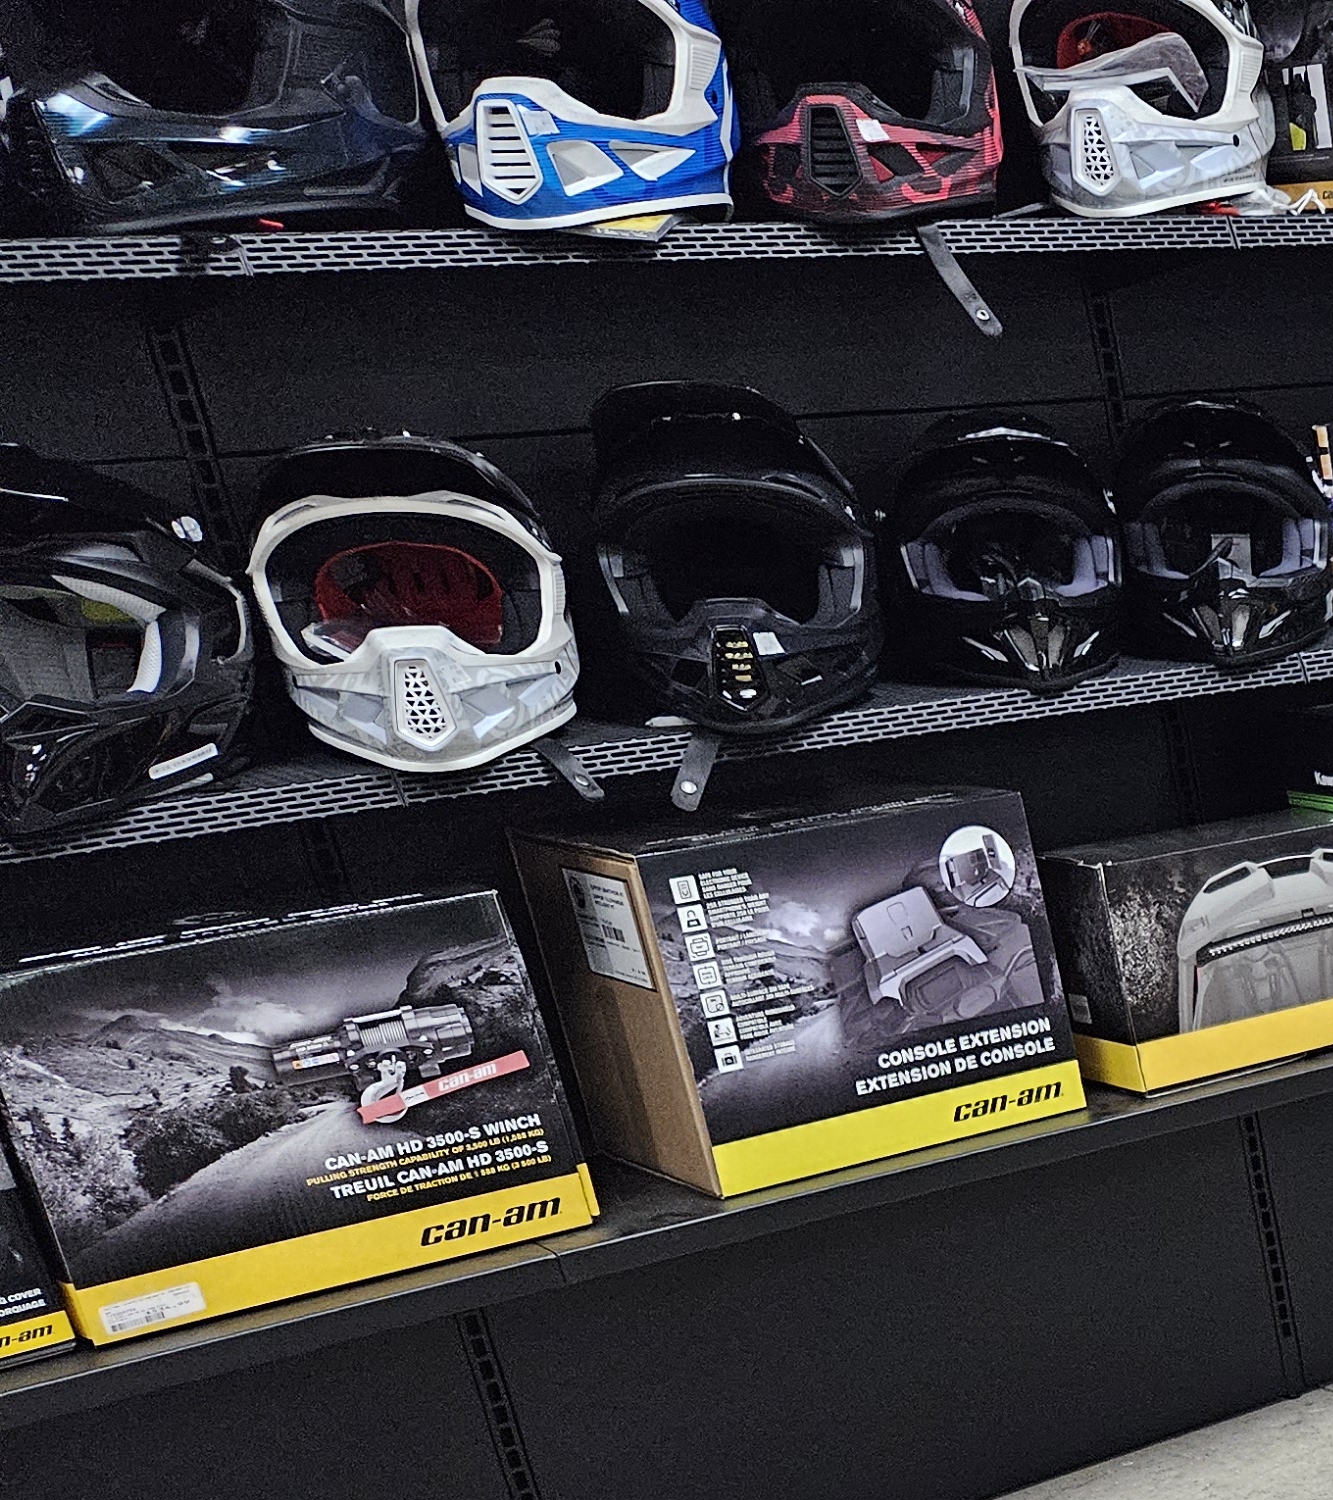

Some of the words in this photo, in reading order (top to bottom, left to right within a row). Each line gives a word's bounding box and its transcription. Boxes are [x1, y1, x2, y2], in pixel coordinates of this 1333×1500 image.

[855, 1060, 952, 1096] EXTENSION
[954, 1054, 979, 1073] DE
[980, 1036, 1056, 1067] CONSOLE
[877, 1038, 958, 1069] CONSOLE
[958, 1016, 1052, 1051] EXTENSION
[438, 1063, 498, 1092] can-am
[953, 1081, 1062, 1122] can-am
[306, 1171, 348, 1187] PULLING
[348, 1160, 398, 1177] STRENGTH
[399, 1148, 450, 1167] CAPABILITY
[451, 1145, 465, 1154] OF
[489, 1137, 501, 1147] LB
[324, 1143, 395, 1171] CAN-AM
[397, 1139, 424, 1156] HD
[425, 1126, 482, 1150] 3500-S
[482, 1113, 542, 1137] WINCH
[329, 1172, 395, 1199] TREUIL
[397, 1161, 464, 1184] CAN-AM
[467, 1155, 492, 1170] HD
[495, 1140, 549, 1163] 3500-S
[367, 1188, 400, 1202] FORCE
[400, 1185, 414, 1195] DE
[415, 1175, 459, 1192] TRACTION
[459, 1172, 473, 1182] DE
[497, 1163, 511, 1173] KG
[536, 1154, 552, 1166] LB)
[421, 1197, 561, 1247] can-am
[0, 1299, 46, 1317] ORQUAGE
[8, 1288, 42, 1303] COVER
[0, 1324, 53, 1347] n-am
